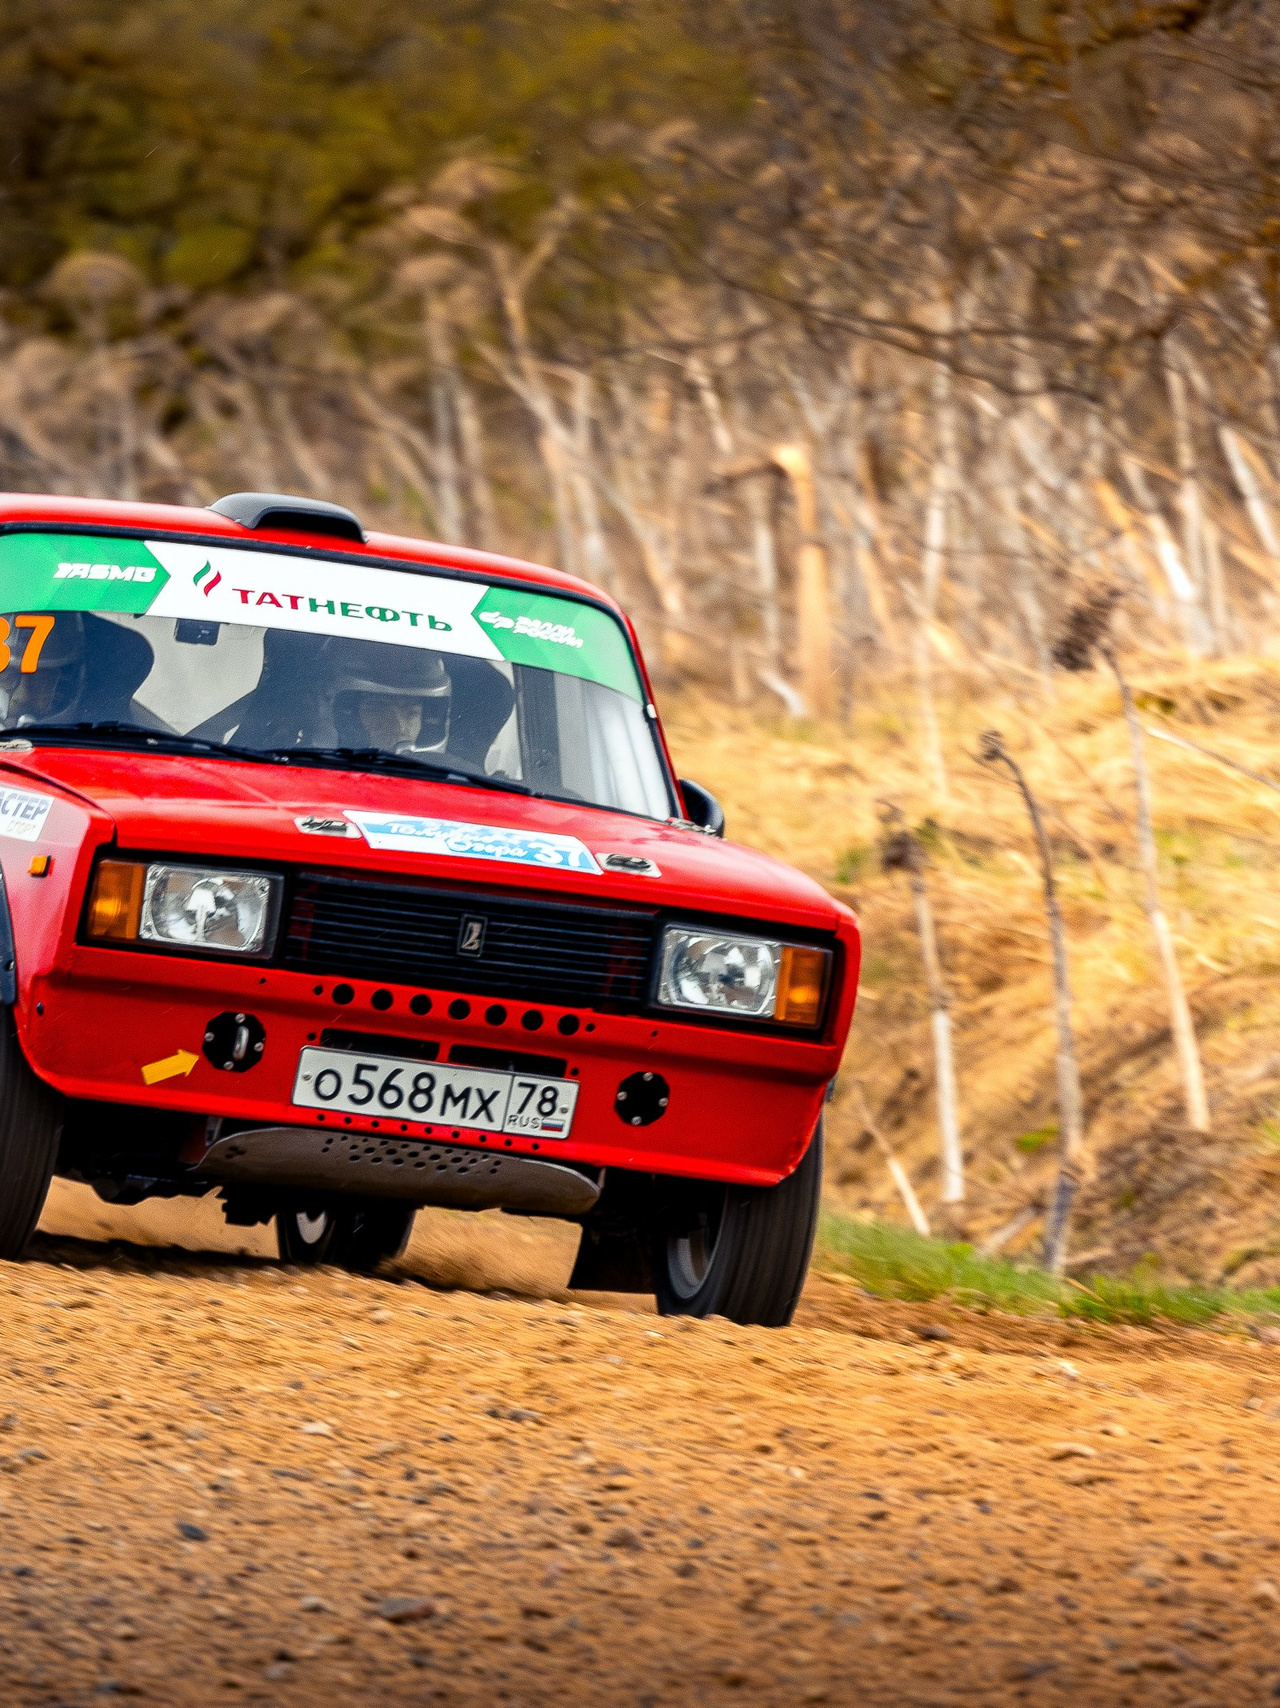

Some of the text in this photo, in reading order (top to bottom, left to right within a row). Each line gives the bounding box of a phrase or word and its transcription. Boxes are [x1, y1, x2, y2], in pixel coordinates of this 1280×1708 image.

[232, 588, 453, 632] ТАТНЕФТЬ
[528, 841, 587, 868] 37
[516, 1081, 560, 1118] 78
[506, 1113, 540, 1130] RUS
